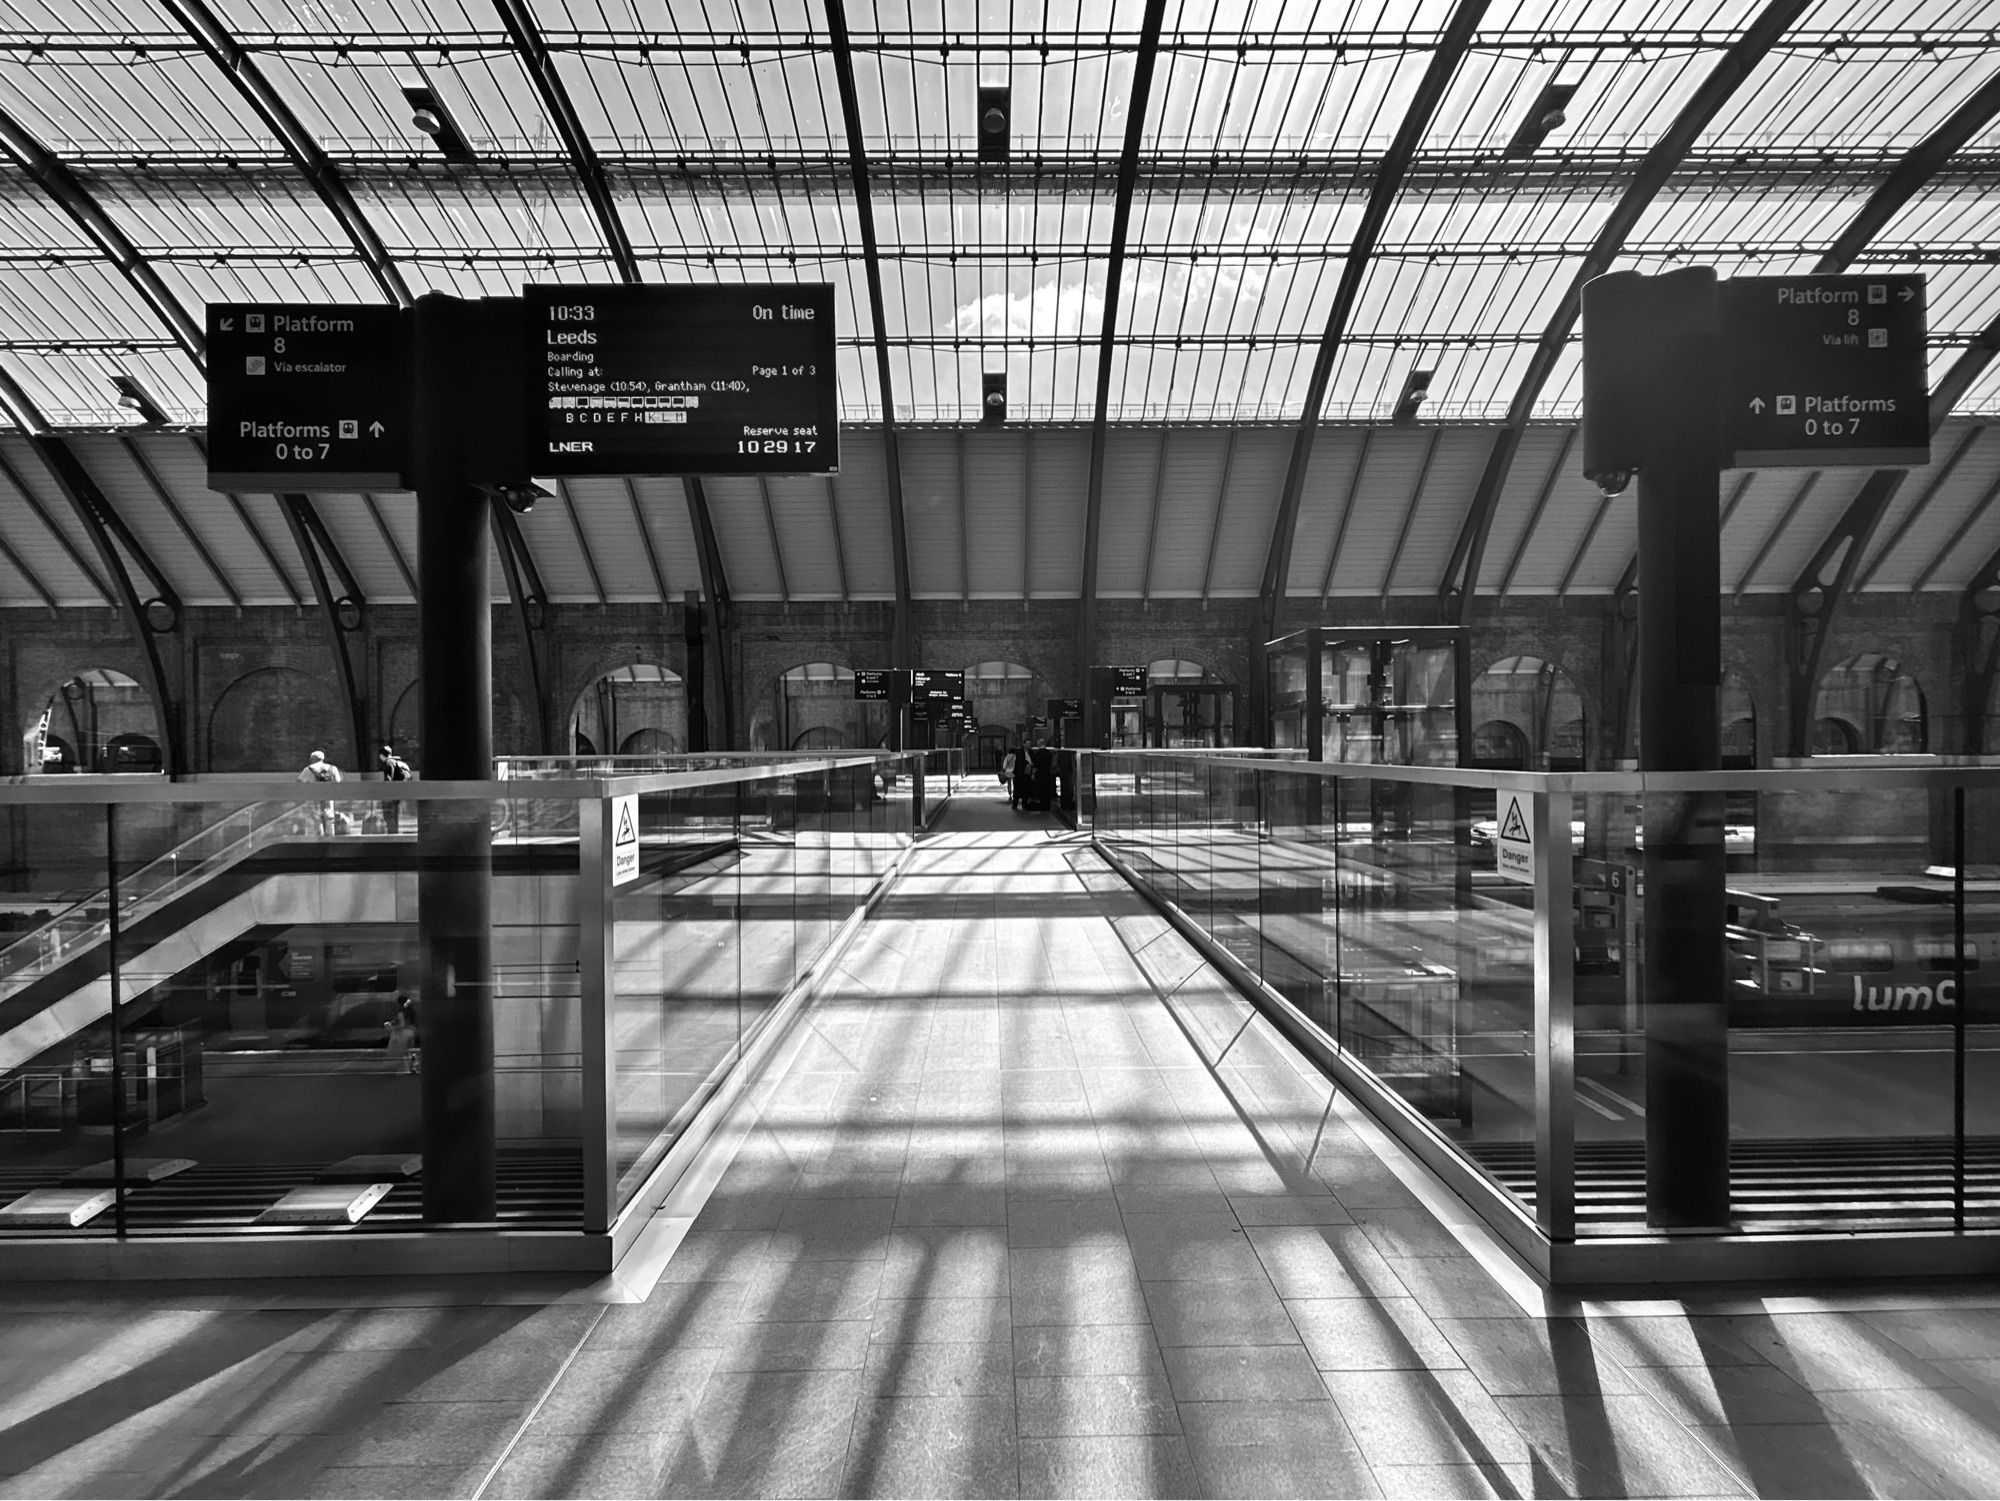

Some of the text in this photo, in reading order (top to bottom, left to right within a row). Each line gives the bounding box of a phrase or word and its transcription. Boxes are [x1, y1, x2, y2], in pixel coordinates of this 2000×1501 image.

[1778, 287, 1858, 304] Platform
[550, 306, 594, 320] 10:33
[753, 305, 814, 319] On time
[1848, 309, 1859, 325] 8
[274, 316, 353, 331] Platform
[547, 330, 598, 345] Leeds
[1823, 334, 1859, 344] Via lift
[274, 337, 285, 353] 8
[548, 352, 593, 363] Boarding
[274, 362, 346, 372] Via escalator
[548, 367, 602, 378] Calling at:
[753, 365, 815, 378] Page 1 of 3
[549, 381, 749, 393] Stevenage (10:54), Grantham (11:40),
[1805, 396, 1896, 413] Platforms
[566, 413, 574, 422] B
[580, 413, 587, 422] C
[594, 413, 601, 422] D
[607, 413, 615, 422] E
[621, 413, 628, 422] F
[635, 413, 642, 422] H
[241, 422, 330, 437] Platforms
[744, 426, 817, 435] Reserve seat
[1806, 418, 1859, 435] 0 to 7
[276, 444, 330, 460] 0 to 7
[550, 442, 593, 452] LNER
[617, 854, 635, 866] Danger
[1503, 848, 1529, 864] Danger
[1612, 872, 1619, 888] 6
